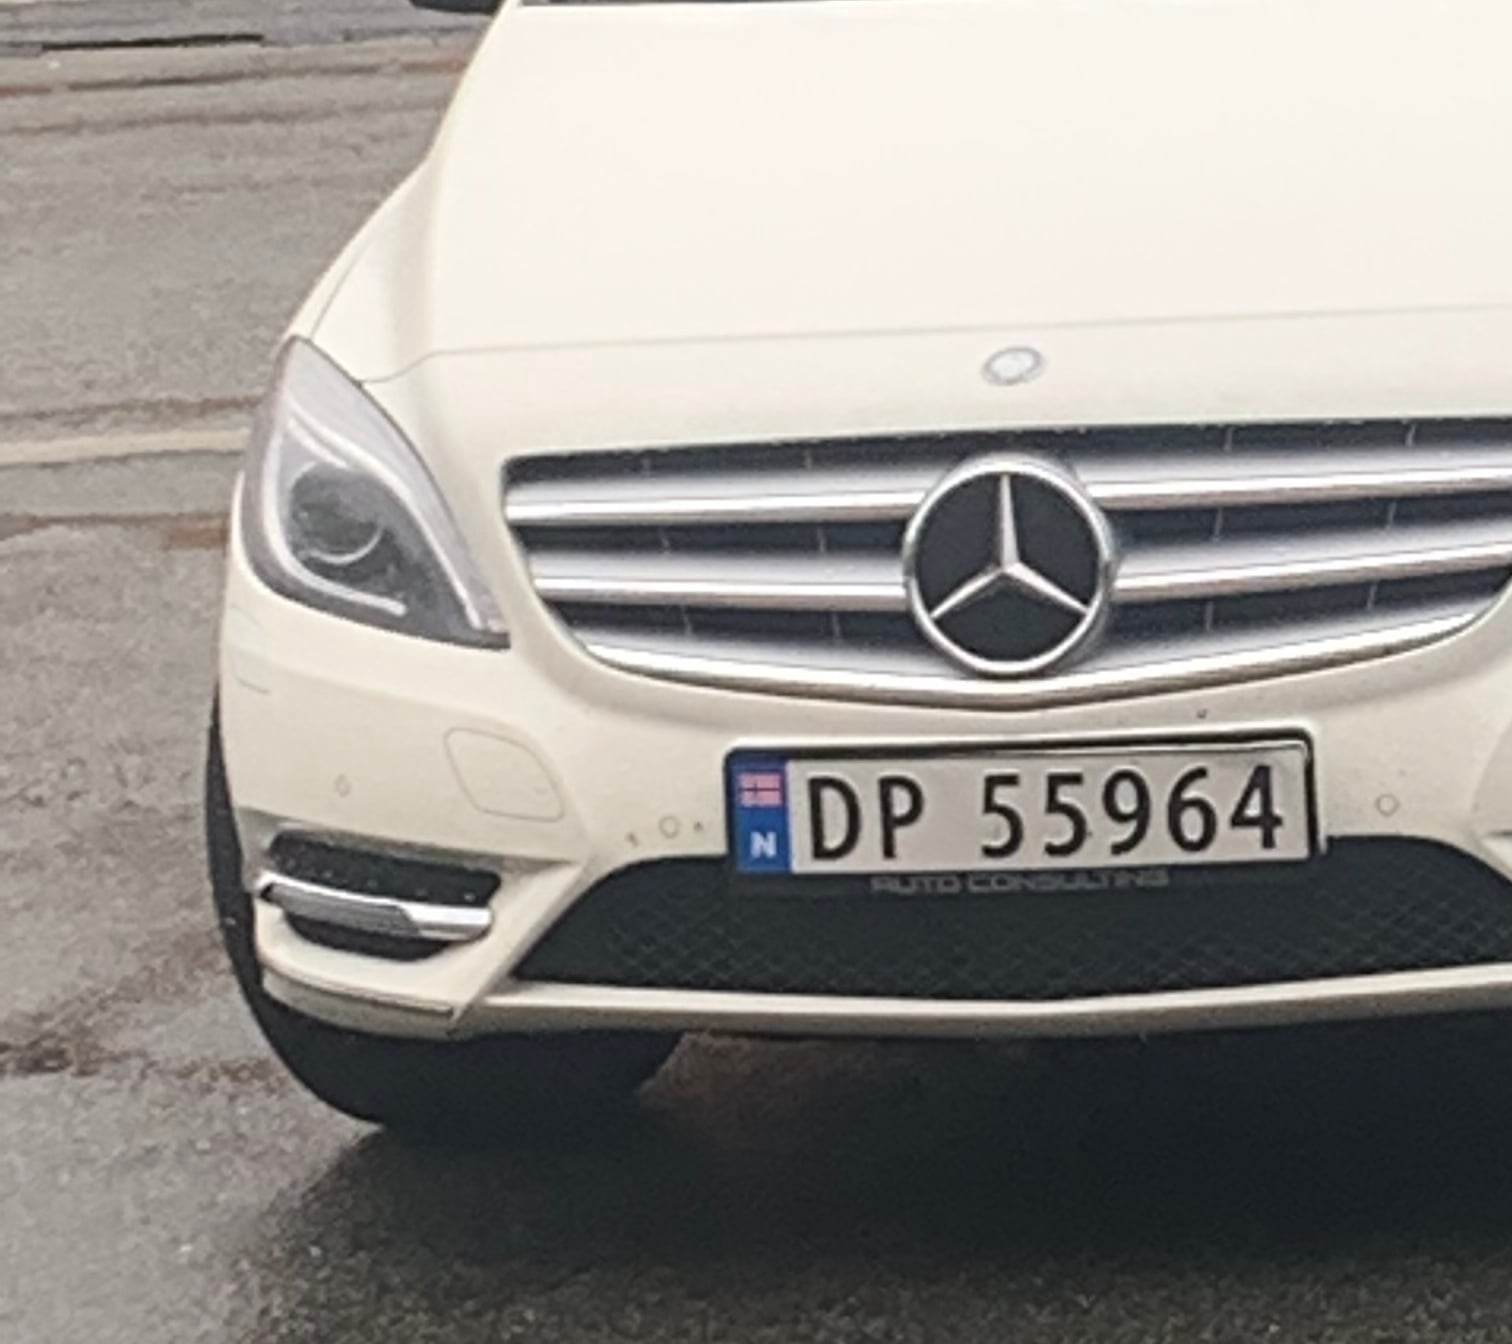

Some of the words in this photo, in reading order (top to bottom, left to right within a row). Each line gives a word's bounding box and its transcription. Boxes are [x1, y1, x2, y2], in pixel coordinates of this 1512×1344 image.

[808, 775, 925, 860] DP
[981, 764, 1283, 858] 55964
[750, 831, 777, 858] N
